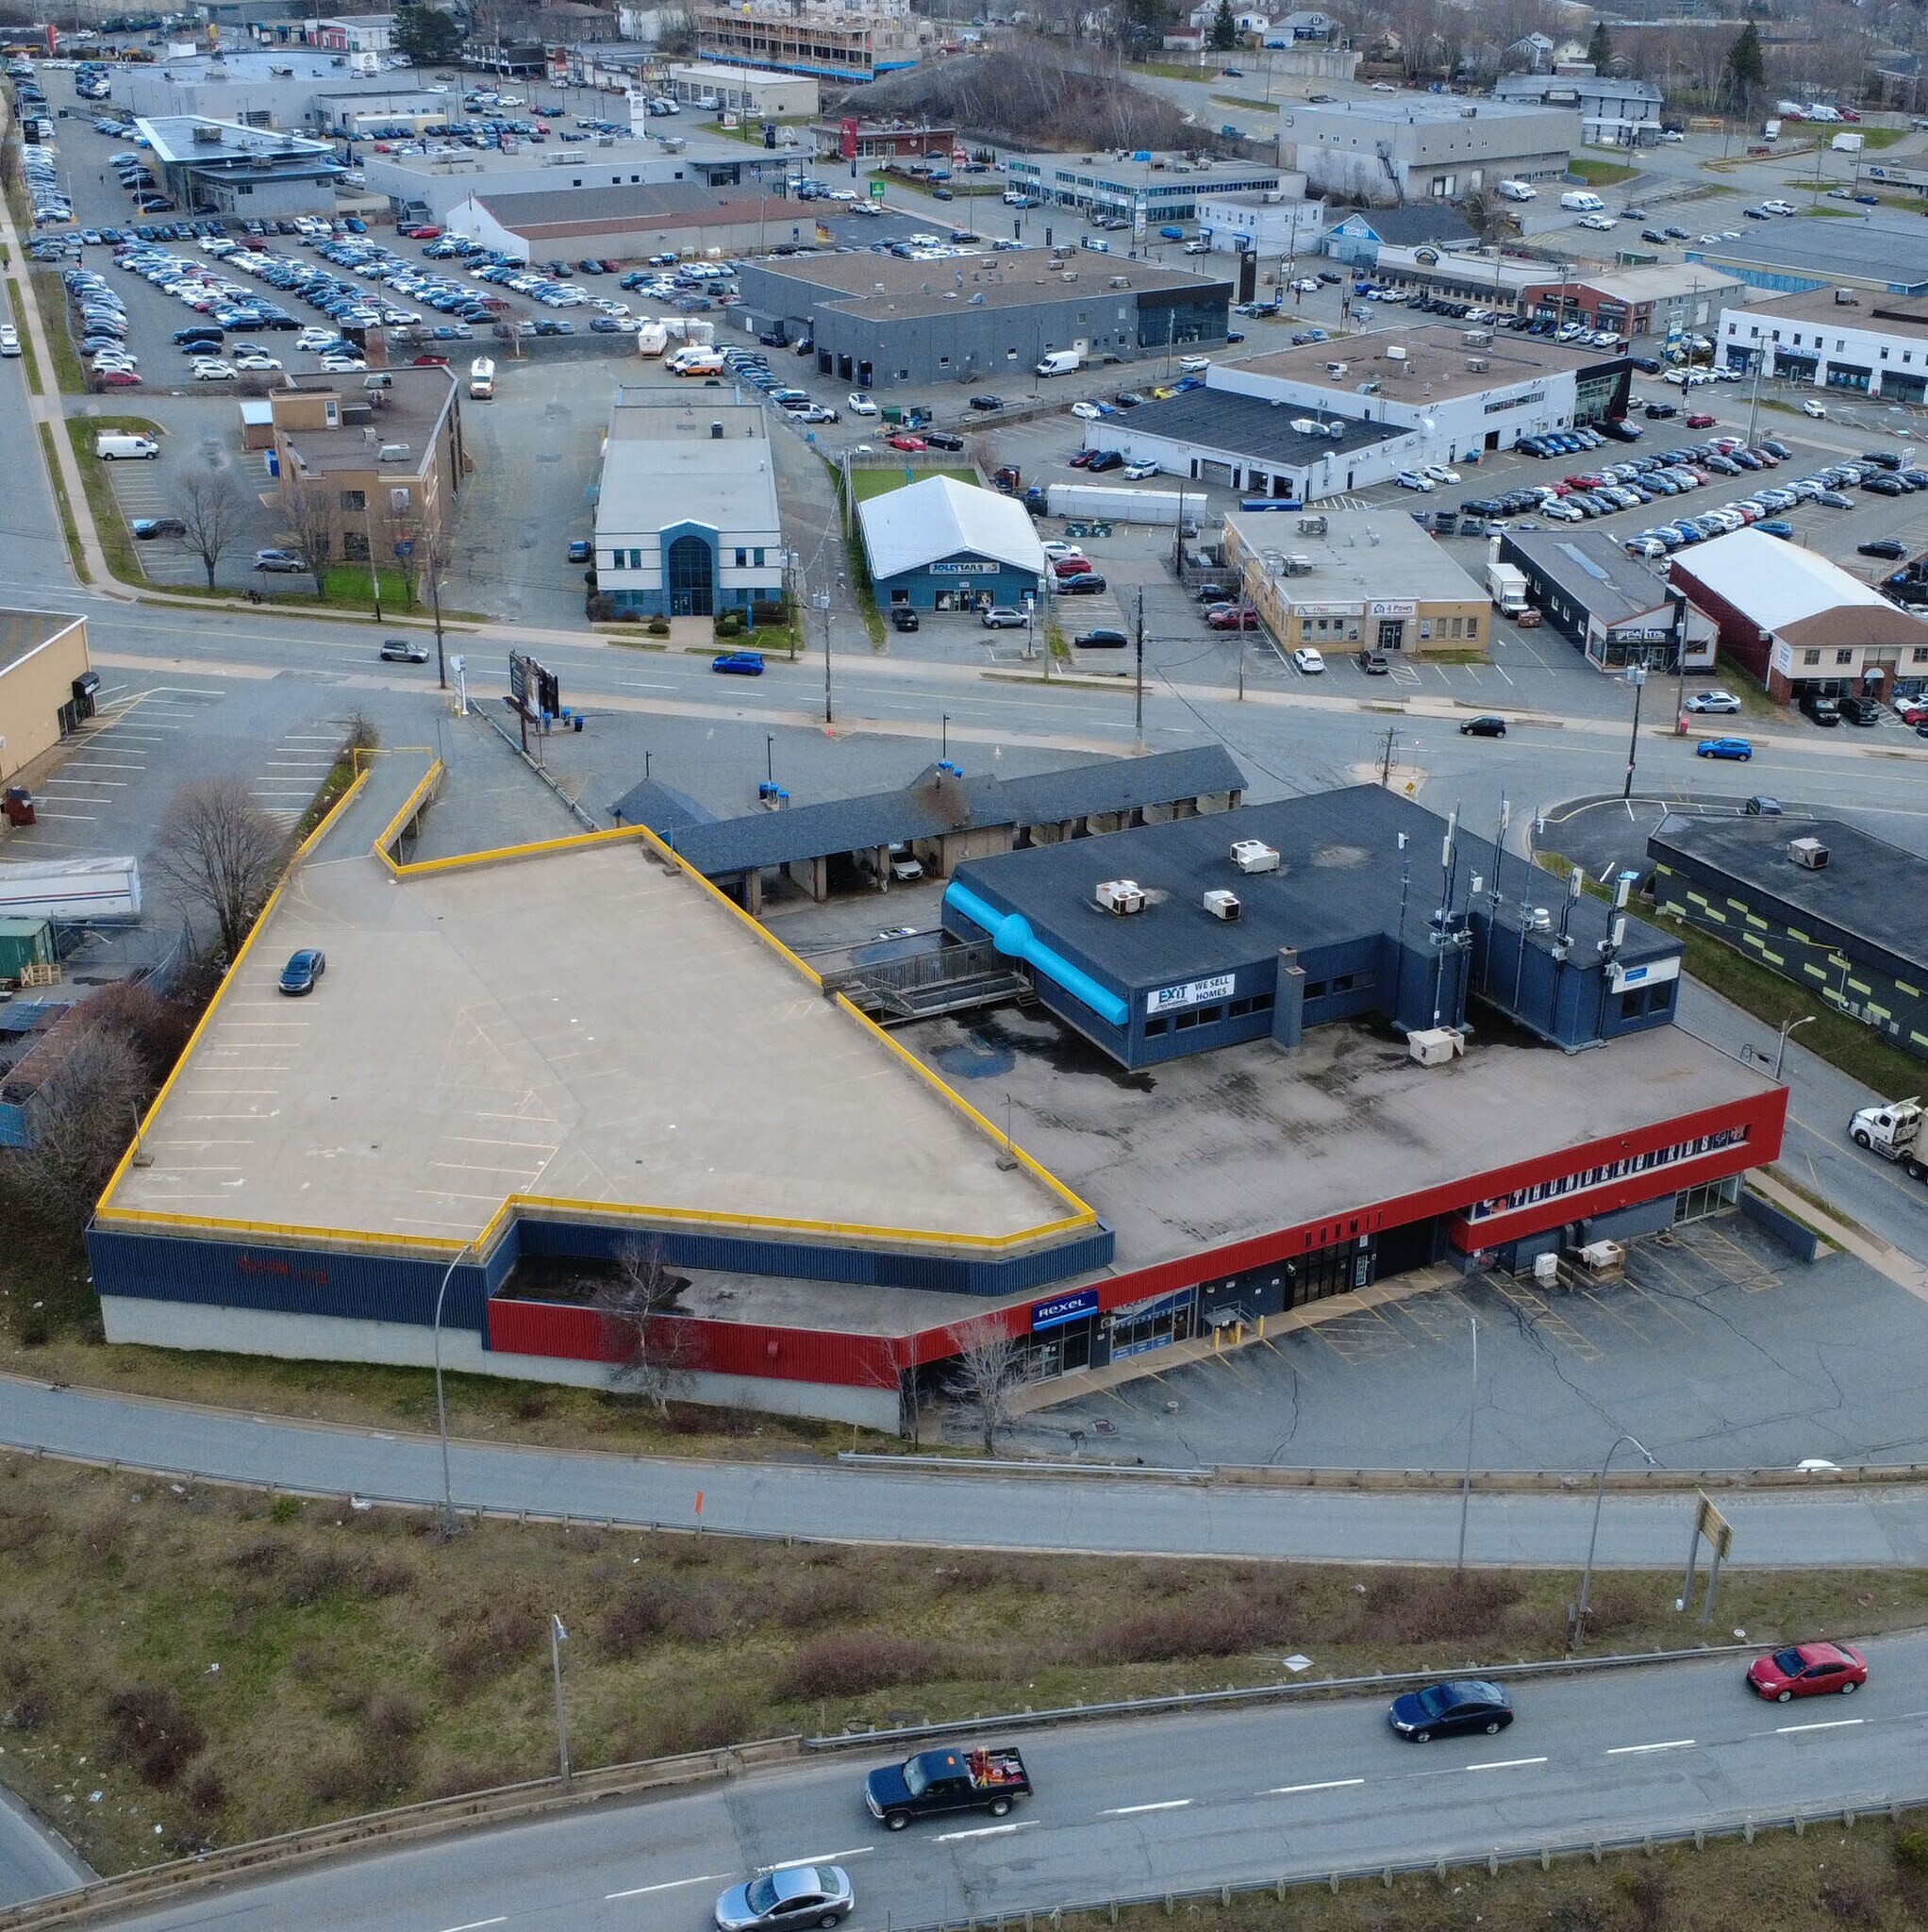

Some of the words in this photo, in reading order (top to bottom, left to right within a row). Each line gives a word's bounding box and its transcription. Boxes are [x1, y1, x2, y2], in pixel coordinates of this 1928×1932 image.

[1194, 981, 1208, 991] WE
[1209, 976, 1229, 988] SELL
[1158, 986, 1188, 1004] EXIT
[1196, 987, 1227, 1002] HOMES
